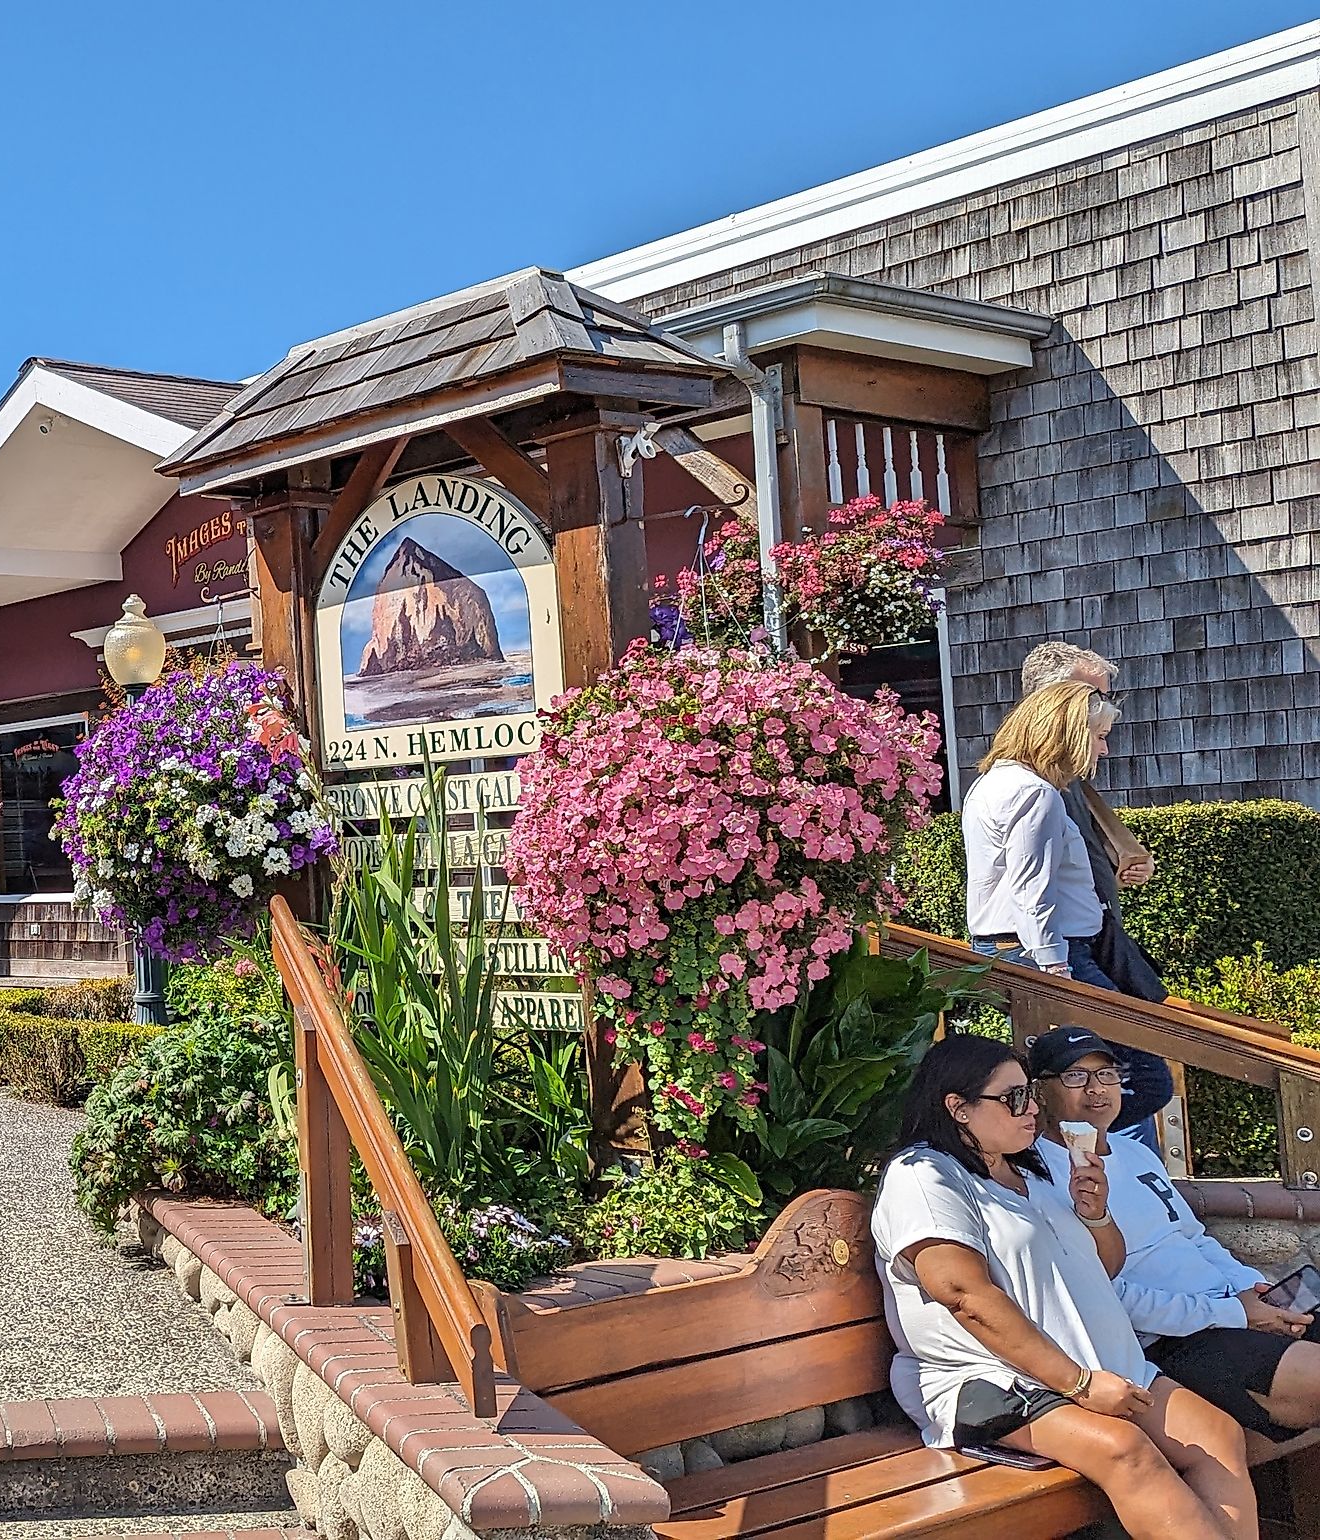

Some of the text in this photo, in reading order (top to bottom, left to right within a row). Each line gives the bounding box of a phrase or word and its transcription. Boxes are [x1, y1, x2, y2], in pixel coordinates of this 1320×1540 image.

[165, 511, 233, 584] IMAGES
[330, 478, 532, 590] THE LANDING
[194, 562, 211, 584] By
[328, 719, 548, 763] 224 N. HEMLOC
[407, 779, 472, 815] CST
[476, 774, 521, 809] GAL
[481, 942, 570, 974] STILLIN
[1136, 1172, 1179, 1222] P
